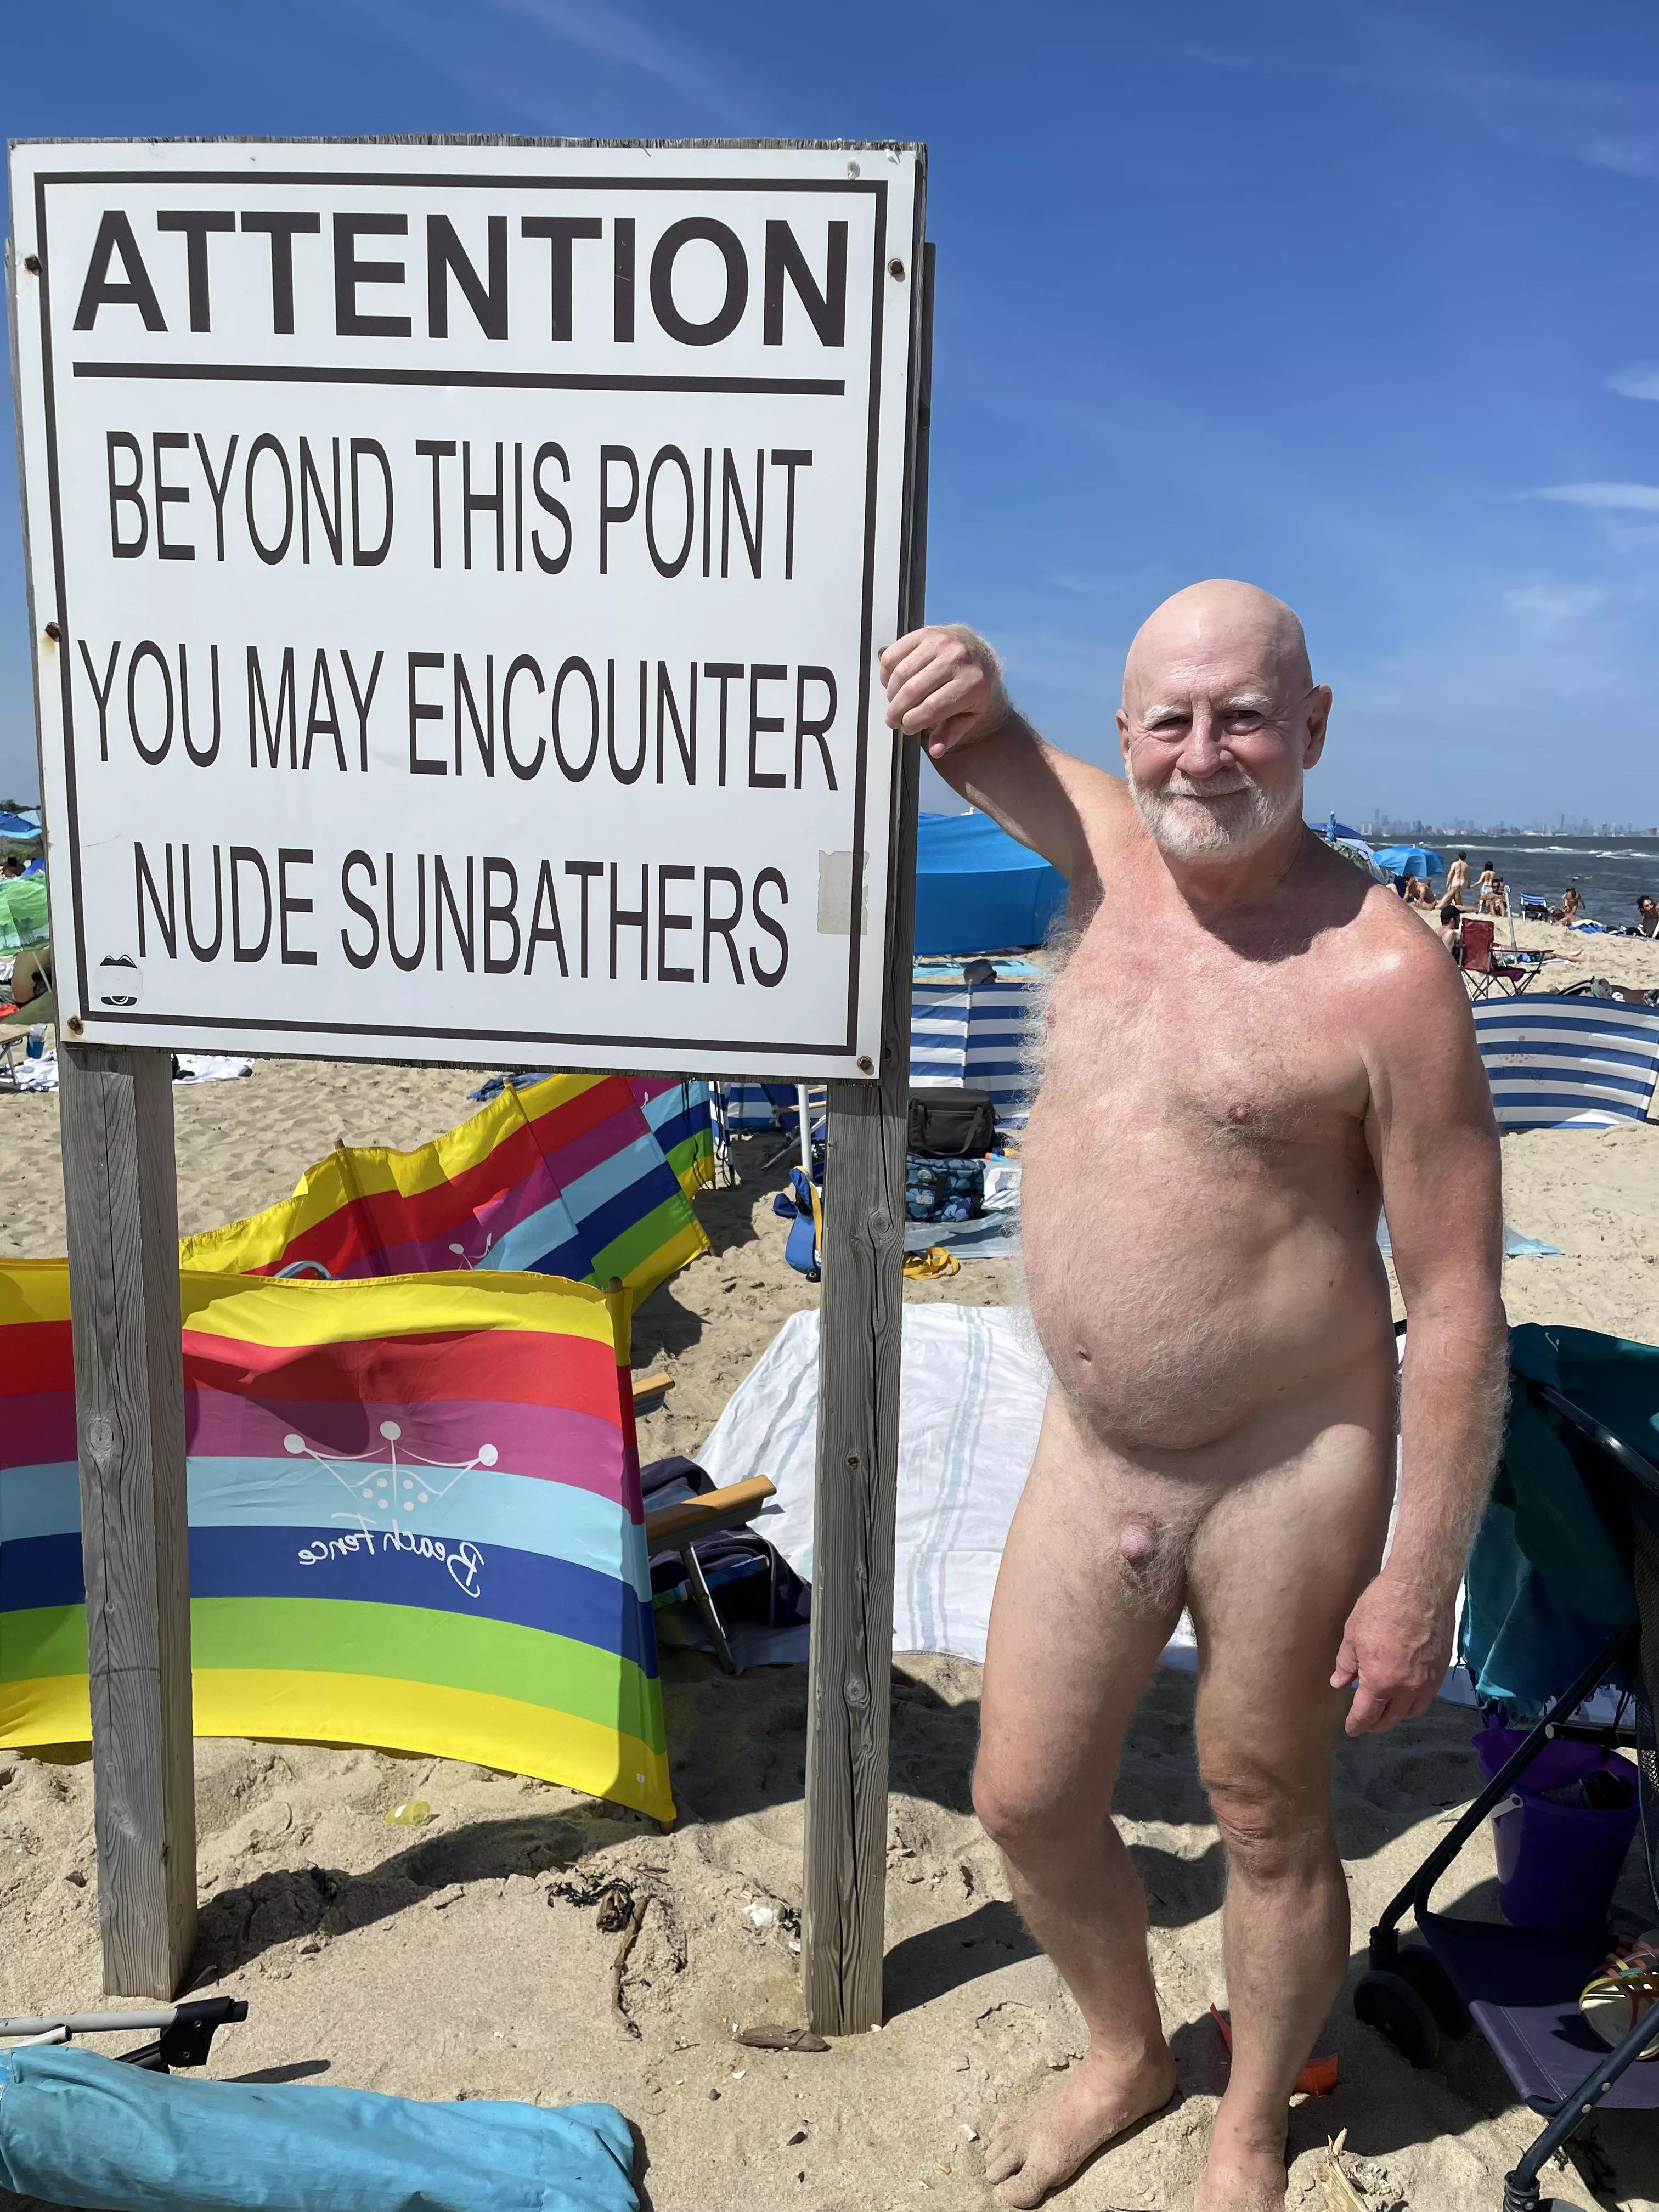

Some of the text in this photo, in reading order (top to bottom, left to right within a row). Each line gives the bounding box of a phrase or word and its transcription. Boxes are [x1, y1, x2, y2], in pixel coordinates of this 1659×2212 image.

[73, 211, 848, 347] ATTENTION
[106, 431, 812, 580] BEYOND THIS POINT
[78, 640, 838, 791] YOU MAY ENCOUNTER
[134, 842, 788, 988] NUDE SUNBATHERS
